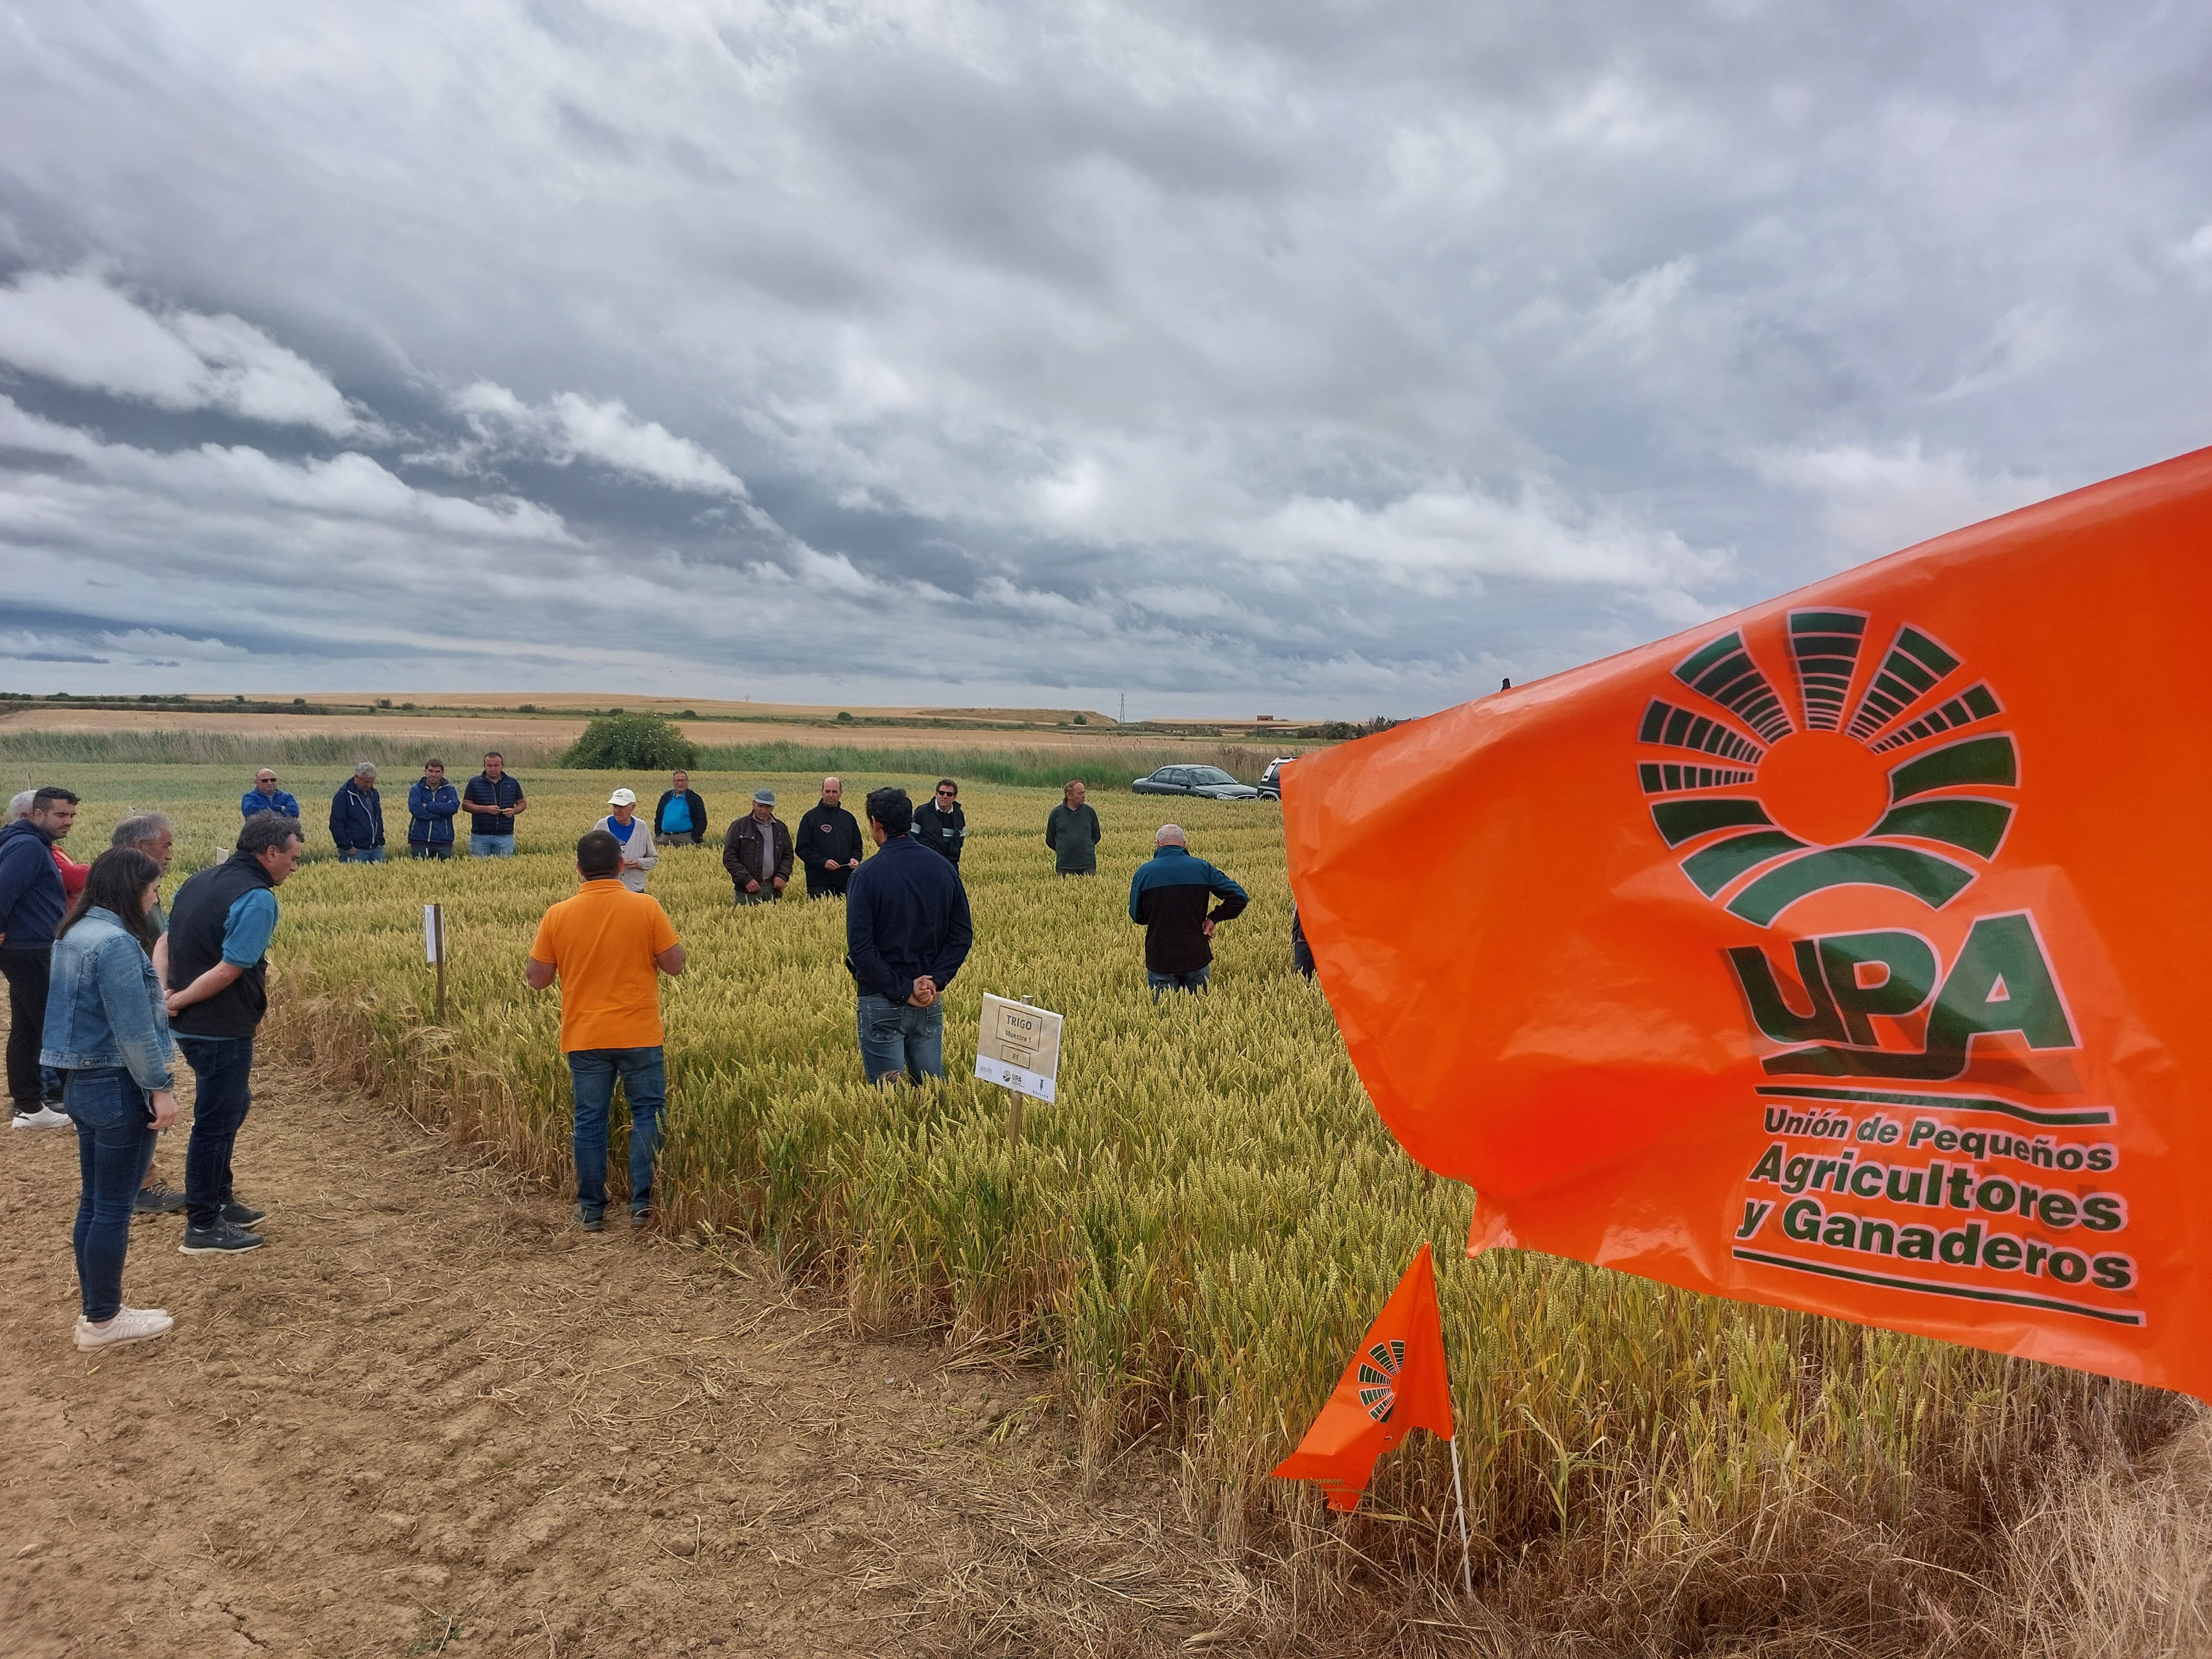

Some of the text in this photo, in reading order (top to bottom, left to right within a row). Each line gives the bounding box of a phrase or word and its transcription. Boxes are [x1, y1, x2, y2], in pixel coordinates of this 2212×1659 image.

[1006, 1015, 1032, 1030] TRIGO
[1723, 908, 2082, 1081] UPA
[1006, 1030, 1027, 1042] Muestra
[1012, 1074, 1022, 1083] UPA
[1764, 1105, 2119, 1173] Unión de Pequeños
[1747, 1140, 2128, 1233] Agricultores
[1735, 1198, 2138, 1291] y Ganaderos
